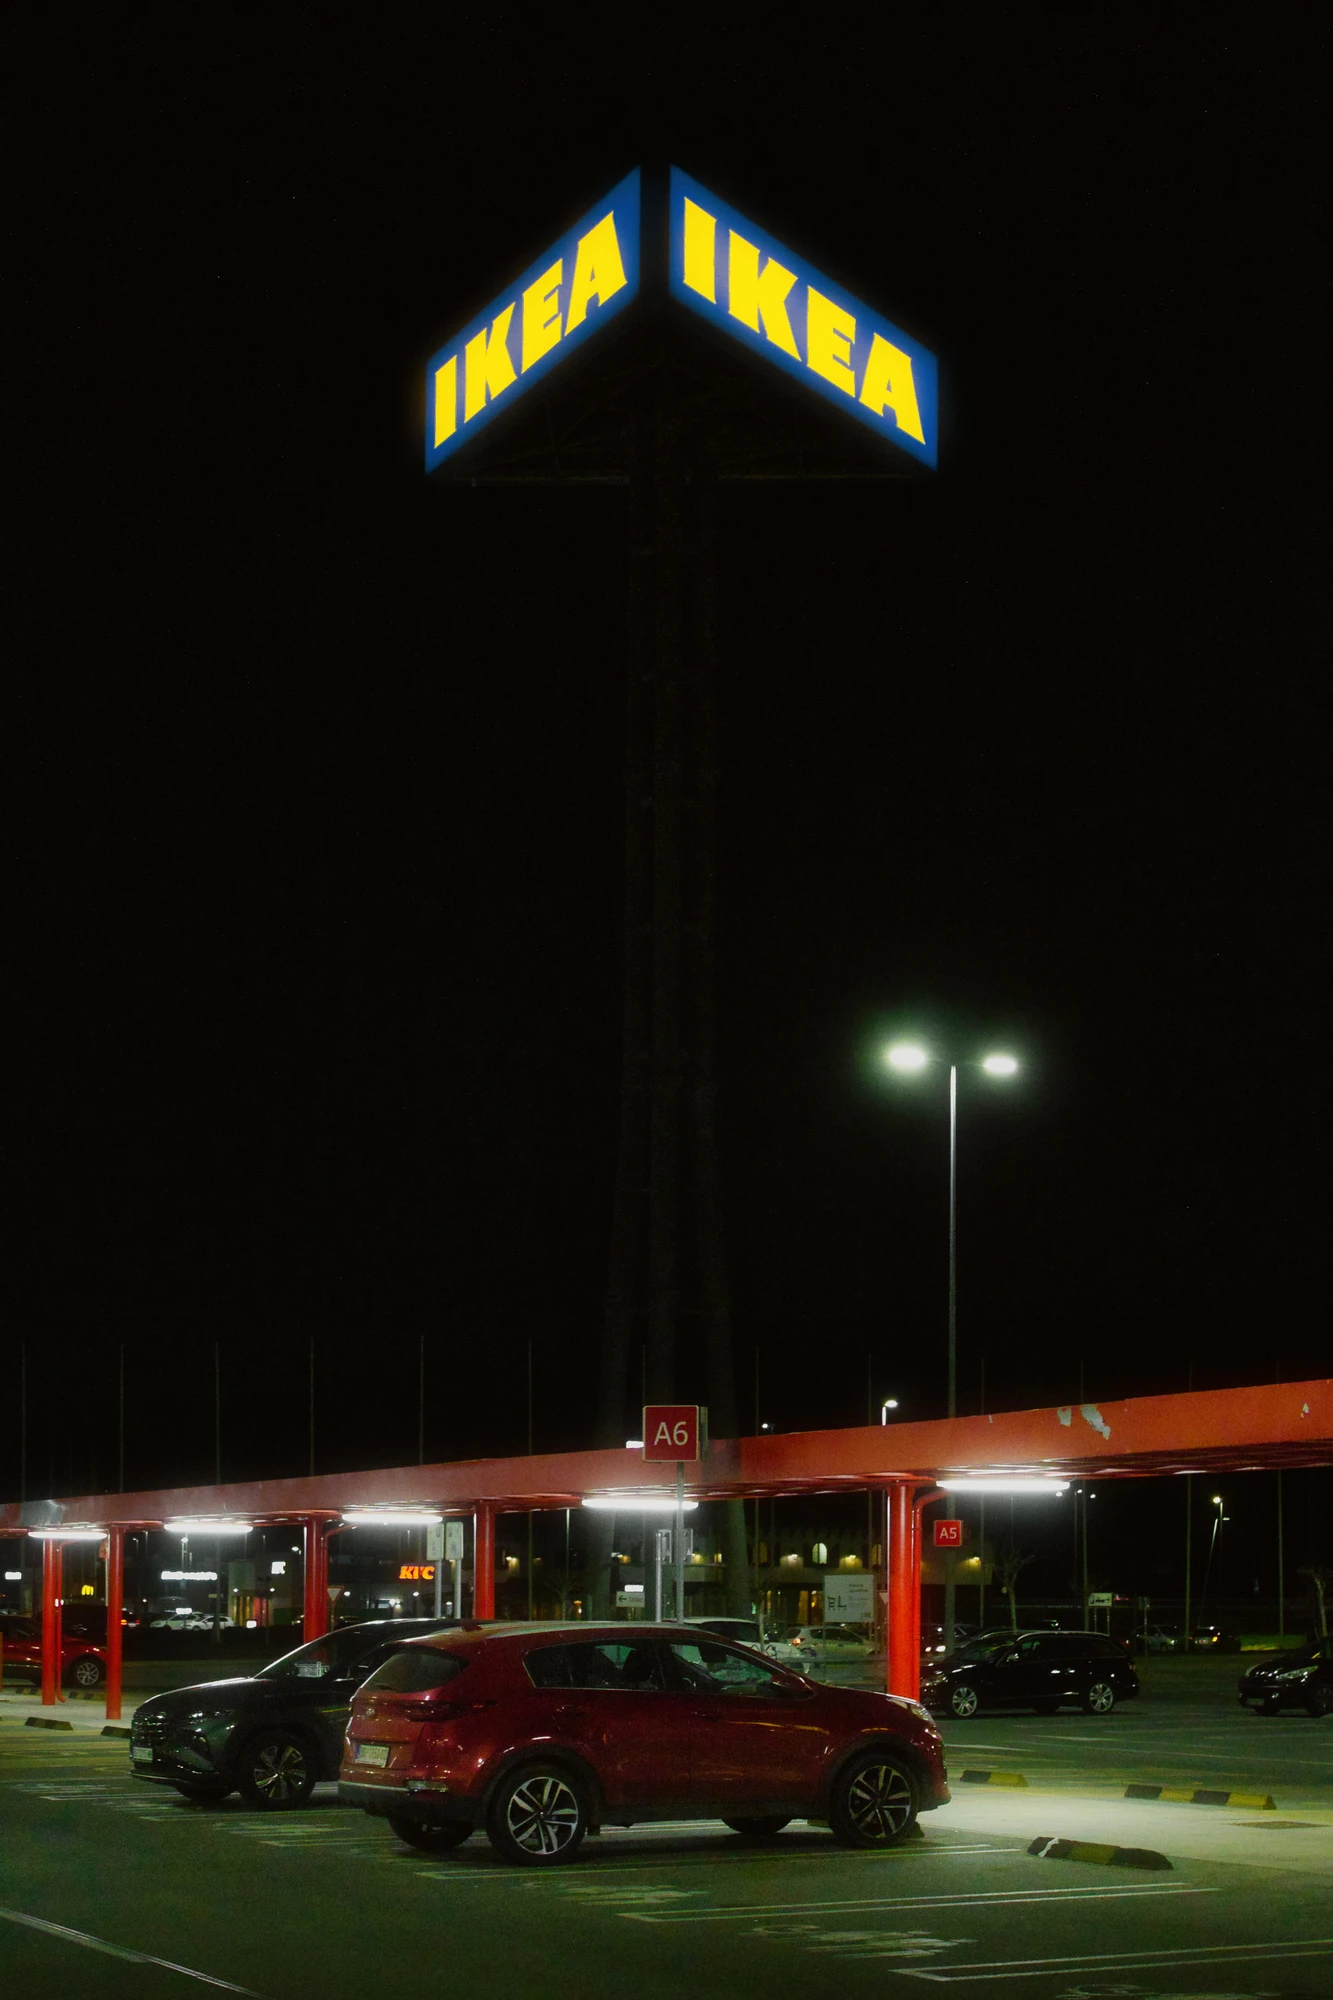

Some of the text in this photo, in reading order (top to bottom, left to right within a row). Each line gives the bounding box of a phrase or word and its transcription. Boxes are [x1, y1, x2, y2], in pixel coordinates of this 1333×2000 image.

[434, 210, 627, 449] IKEA
[683, 196, 925, 445] IKEA
[653, 1421, 688, 1446] A6
[939, 1527, 957, 1539] A5
[399, 1565, 435, 1580] KFC
